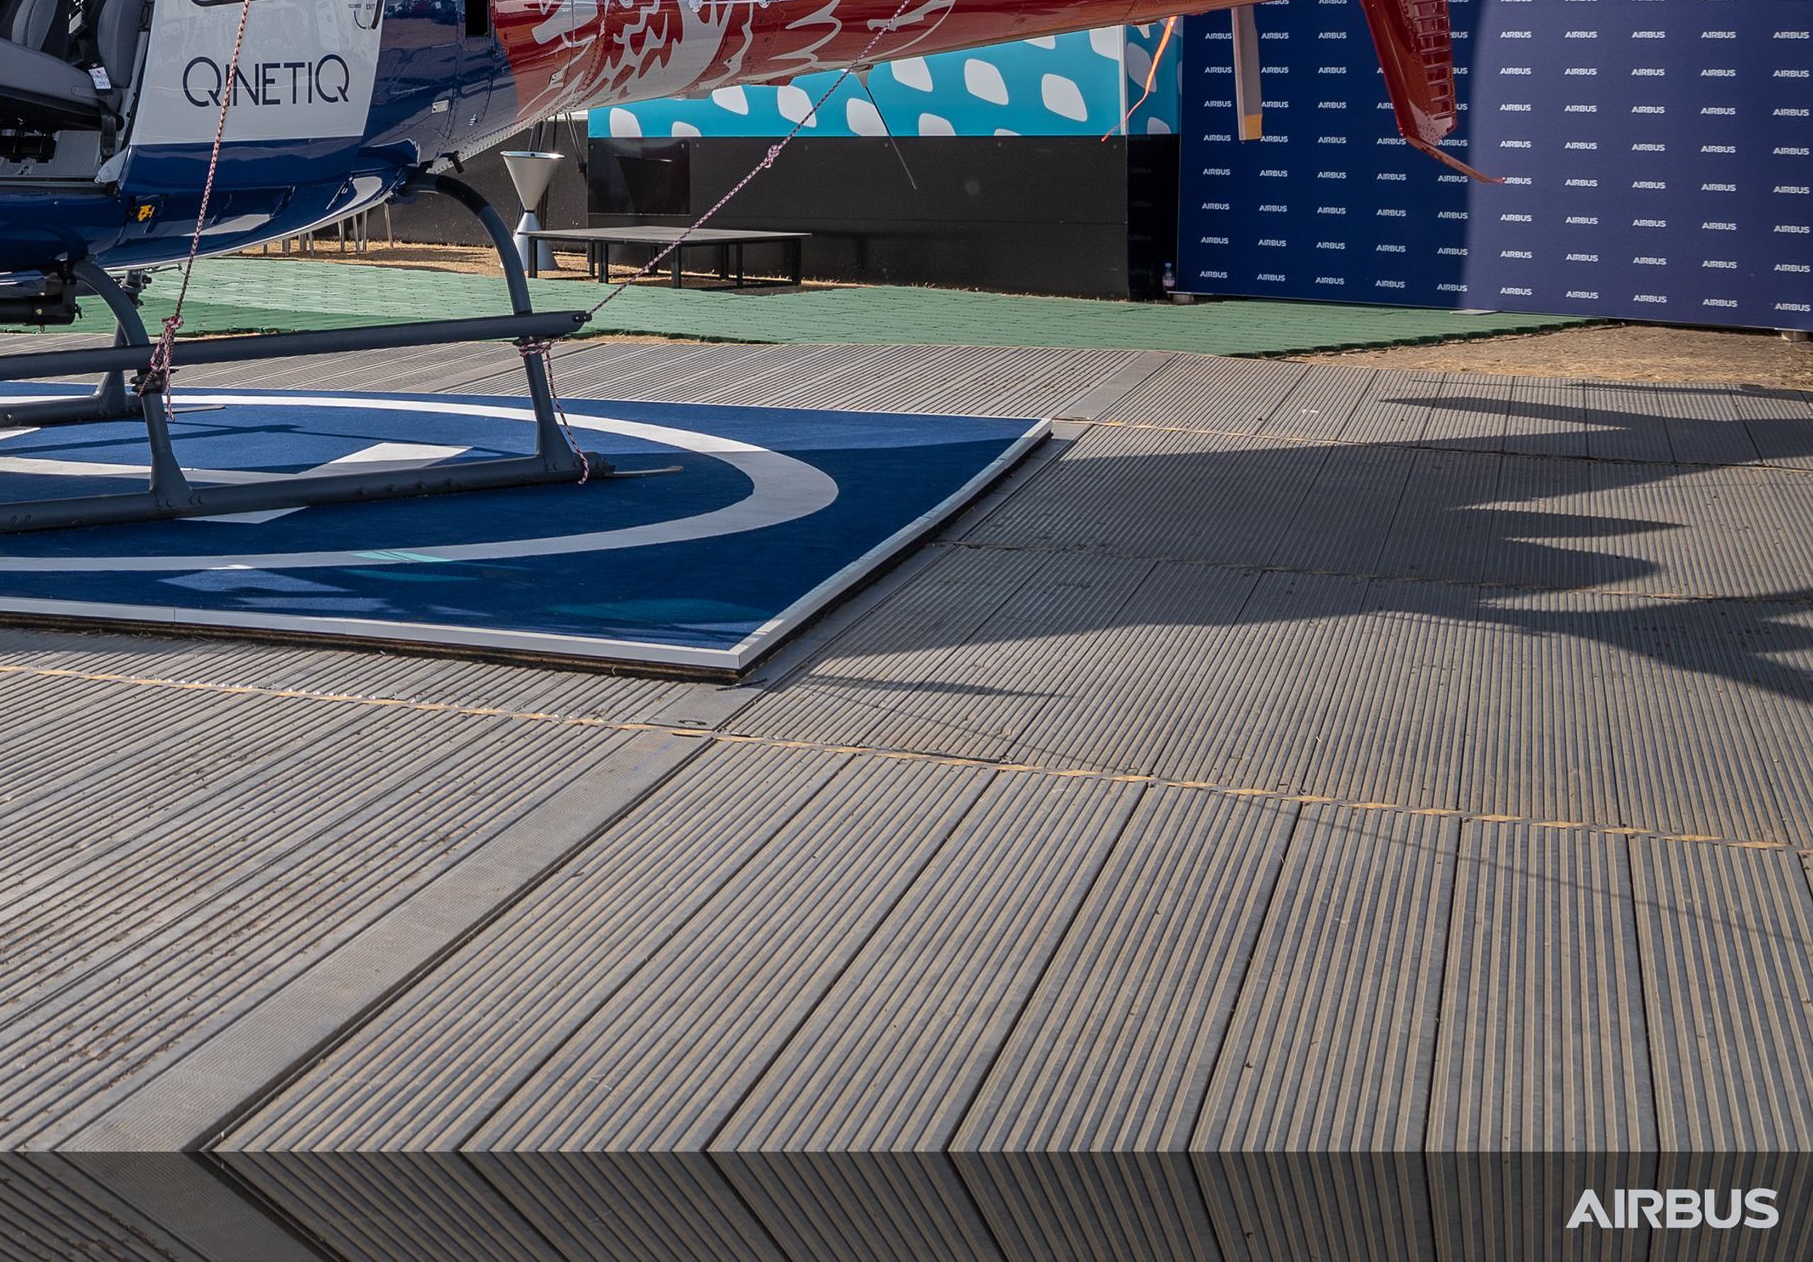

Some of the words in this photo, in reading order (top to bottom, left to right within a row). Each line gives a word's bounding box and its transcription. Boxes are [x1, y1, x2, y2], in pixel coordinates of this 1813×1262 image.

[1317, 31, 1347, 39] AIRBUS
[1499, 30, 1531, 38] AIRBUS
[1564, 30, 1597, 38] AIRBUS
[1631, 30, 1665, 38] AIRBUS
[1700, 30, 1736, 38] AIRBUS
[1772, 31, 1810, 39] AIRBUS
[1317, 66, 1346, 74] AIRBUS
[1564, 67, 1597, 75] AIRBUS
[1630, 68, 1665, 76] AIRBUS
[1700, 68, 1736, 76] AIRBUS
[1772, 69, 1809, 77] AIRBUS
[182, 55, 350, 109] QINETIQ
[1499, 103, 1531, 111] AIRBUS
[1564, 104, 1597, 112] AIRBUS
[1630, 105, 1665, 113] AIRBUS
[1700, 107, 1736, 115] AIRBUS
[1772, 108, 1809, 116] AIRBUS
[1376, 137, 1406, 145] AIRBUS
[1437, 138, 1467, 146] AIRBUS
[1499, 140, 1531, 148] AIRBUS
[1564, 141, 1597, 149] AIRBUS
[1631, 143, 1665, 151] AIRBUS
[1700, 145, 1736, 153] AIRBUS
[1772, 147, 1810, 155] AIRBUS
[1376, 172, 1406, 180] AIRBUS
[1436, 174, 1468, 182] AIRBUS
[1564, 179, 1598, 187] AIRBUS
[1631, 181, 1666, 189] AIRBUS
[1700, 183, 1736, 191] AIRBUS
[1772, 186, 1810, 194] AIRBUS
[1375, 209, 1406, 217] AIRBUS
[1437, 211, 1468, 219] AIRBUS
[1499, 213, 1532, 221] AIRBUS
[1564, 216, 1598, 224] AIRBUS
[1631, 219, 1666, 227] AIRBUS
[1701, 222, 1737, 230] AIRBUS
[1773, 225, 1810, 233] AIRBUS
[1375, 244, 1406, 252] AIRBUS
[1436, 247, 1468, 255] AIRBUS
[1499, 250, 1532, 258] AIRBUS
[1565, 254, 1598, 262] AIRBUS
[1632, 257, 1666, 265] AIRBUS
[1701, 260, 1737, 268] AIRBUS
[1773, 264, 1810, 272] AIRBUS
[1374, 280, 1405, 288] AIRBUS
[1436, 284, 1467, 292] AIRBUS
[1499, 287, 1532, 295] AIRBUS
[1565, 291, 1598, 299] AIRBUS
[1632, 295, 1667, 303] AIRBUS
[1702, 299, 1738, 307] AIRBUS
[1773, 303, 1811, 312] AIRBUS
